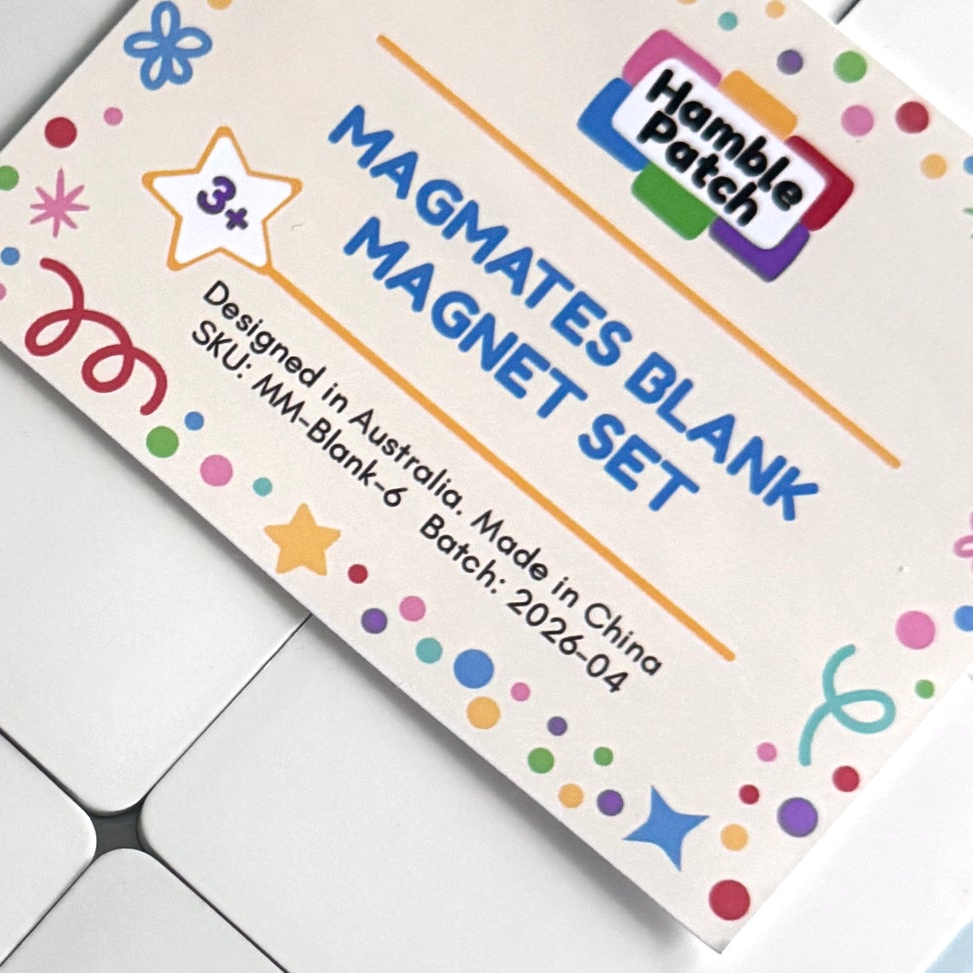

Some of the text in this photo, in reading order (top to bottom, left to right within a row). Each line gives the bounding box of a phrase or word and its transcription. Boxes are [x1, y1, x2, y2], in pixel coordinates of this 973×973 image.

[197, 176, 248, 230] 3+
[634, 109, 762, 229] Patch
[643, 67, 805, 213] Hamble
[328, 105, 819, 521] MAGMATES BLANK
[343, 216, 700, 512] MAGNET SET
[191, 320, 629, 693] SKU: MM-Blank-6 Batch: 2026-04
[203, 280, 662, 676] Designed in Australia. Made in China
